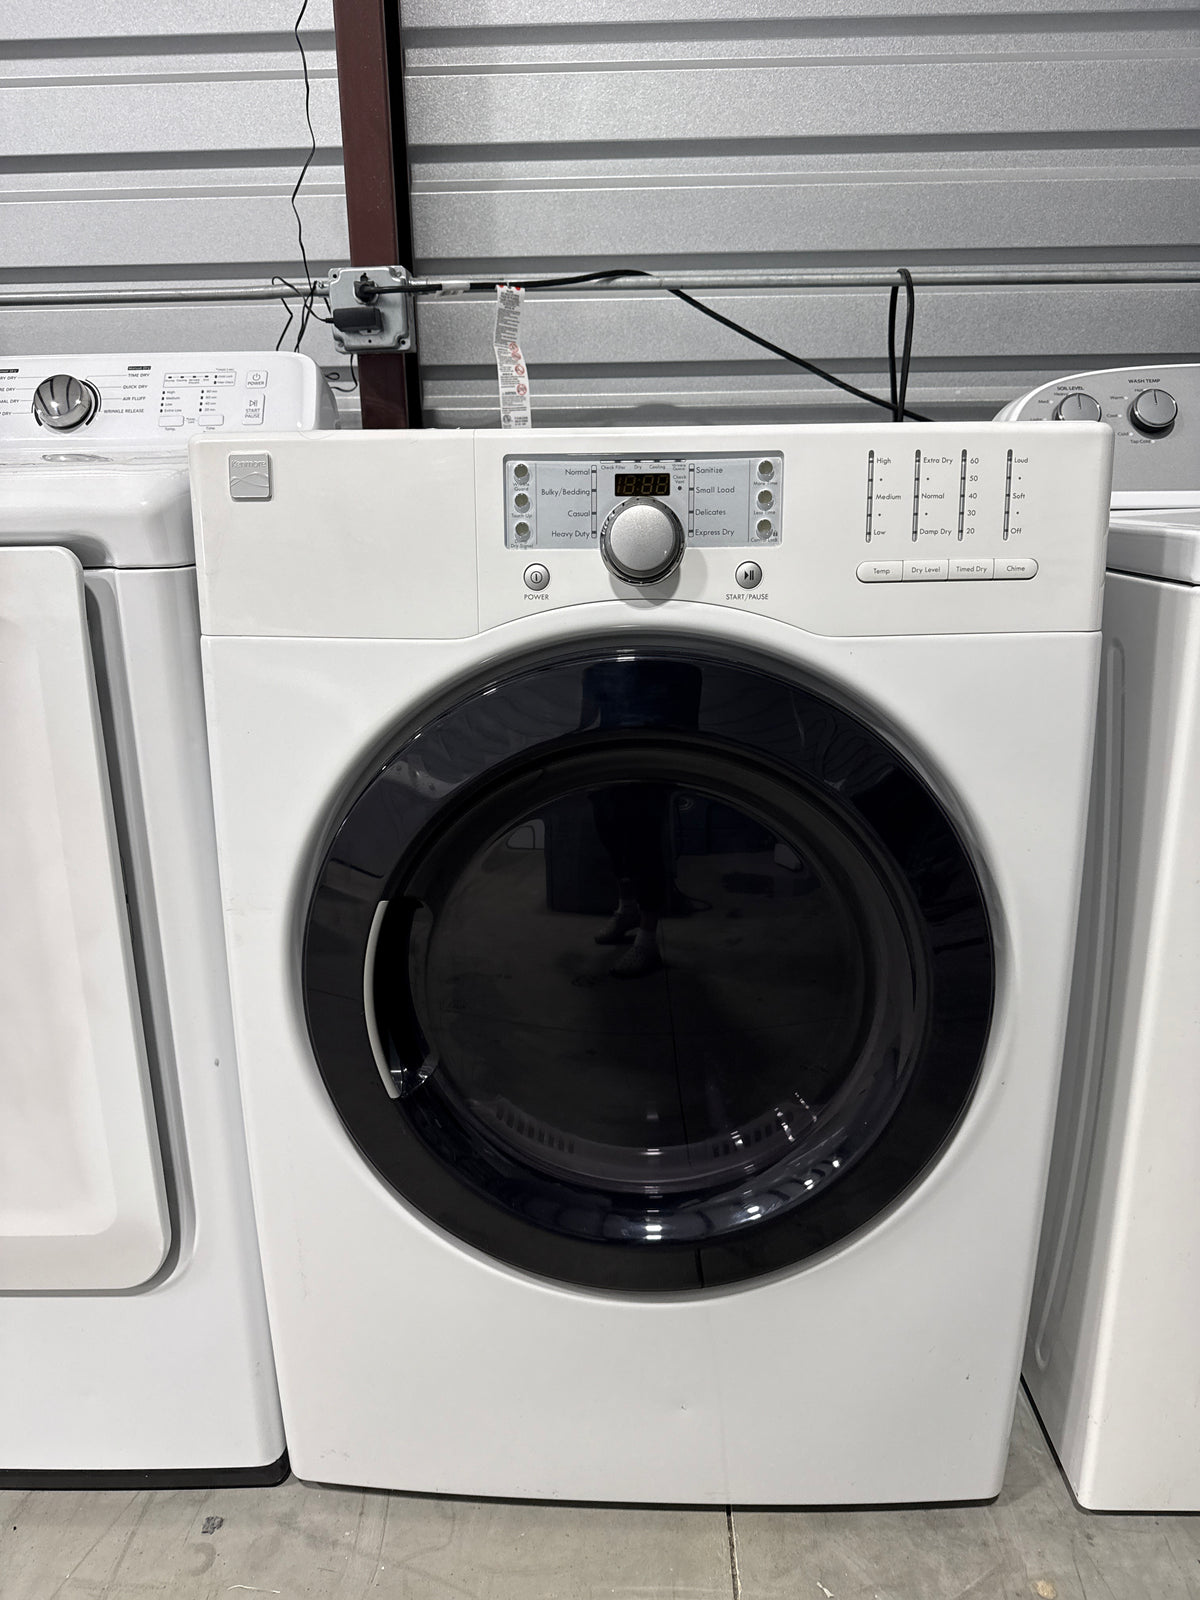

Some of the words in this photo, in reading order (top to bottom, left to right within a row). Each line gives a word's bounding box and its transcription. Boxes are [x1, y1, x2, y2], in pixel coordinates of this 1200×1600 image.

[541, 488, 590, 497] Bulky/Bedding
[552, 530, 573, 538] Heavy
[575, 530, 590, 539] Duty
[920, 528, 939, 536] Damp
[874, 568, 890, 576] Temp
[975, 566, 988, 574] Dry
